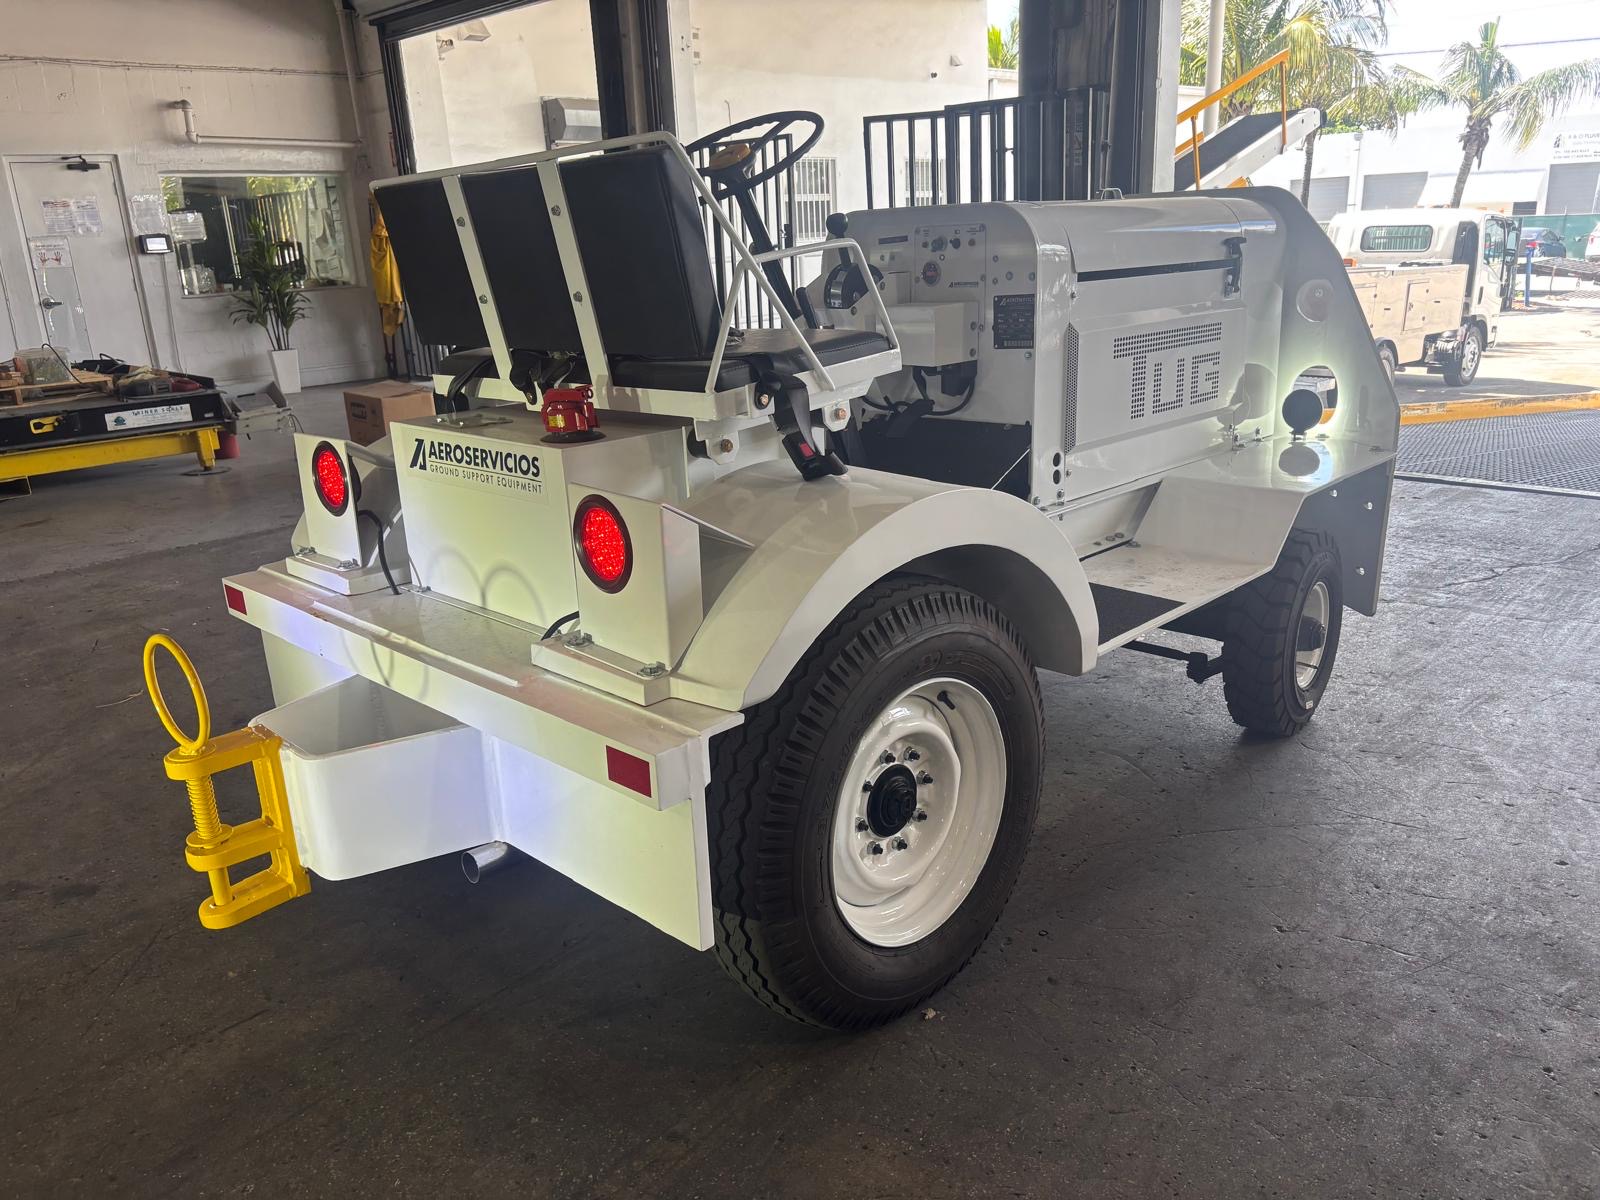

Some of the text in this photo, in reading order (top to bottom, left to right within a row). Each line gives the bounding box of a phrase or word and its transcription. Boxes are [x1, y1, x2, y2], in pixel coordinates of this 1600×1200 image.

[1113, 321, 1222, 420] TUG
[428, 440, 540, 478] AEROSERVICIOS
[430, 464, 542, 494] GROUND SUPPORT EQUIPMENT
